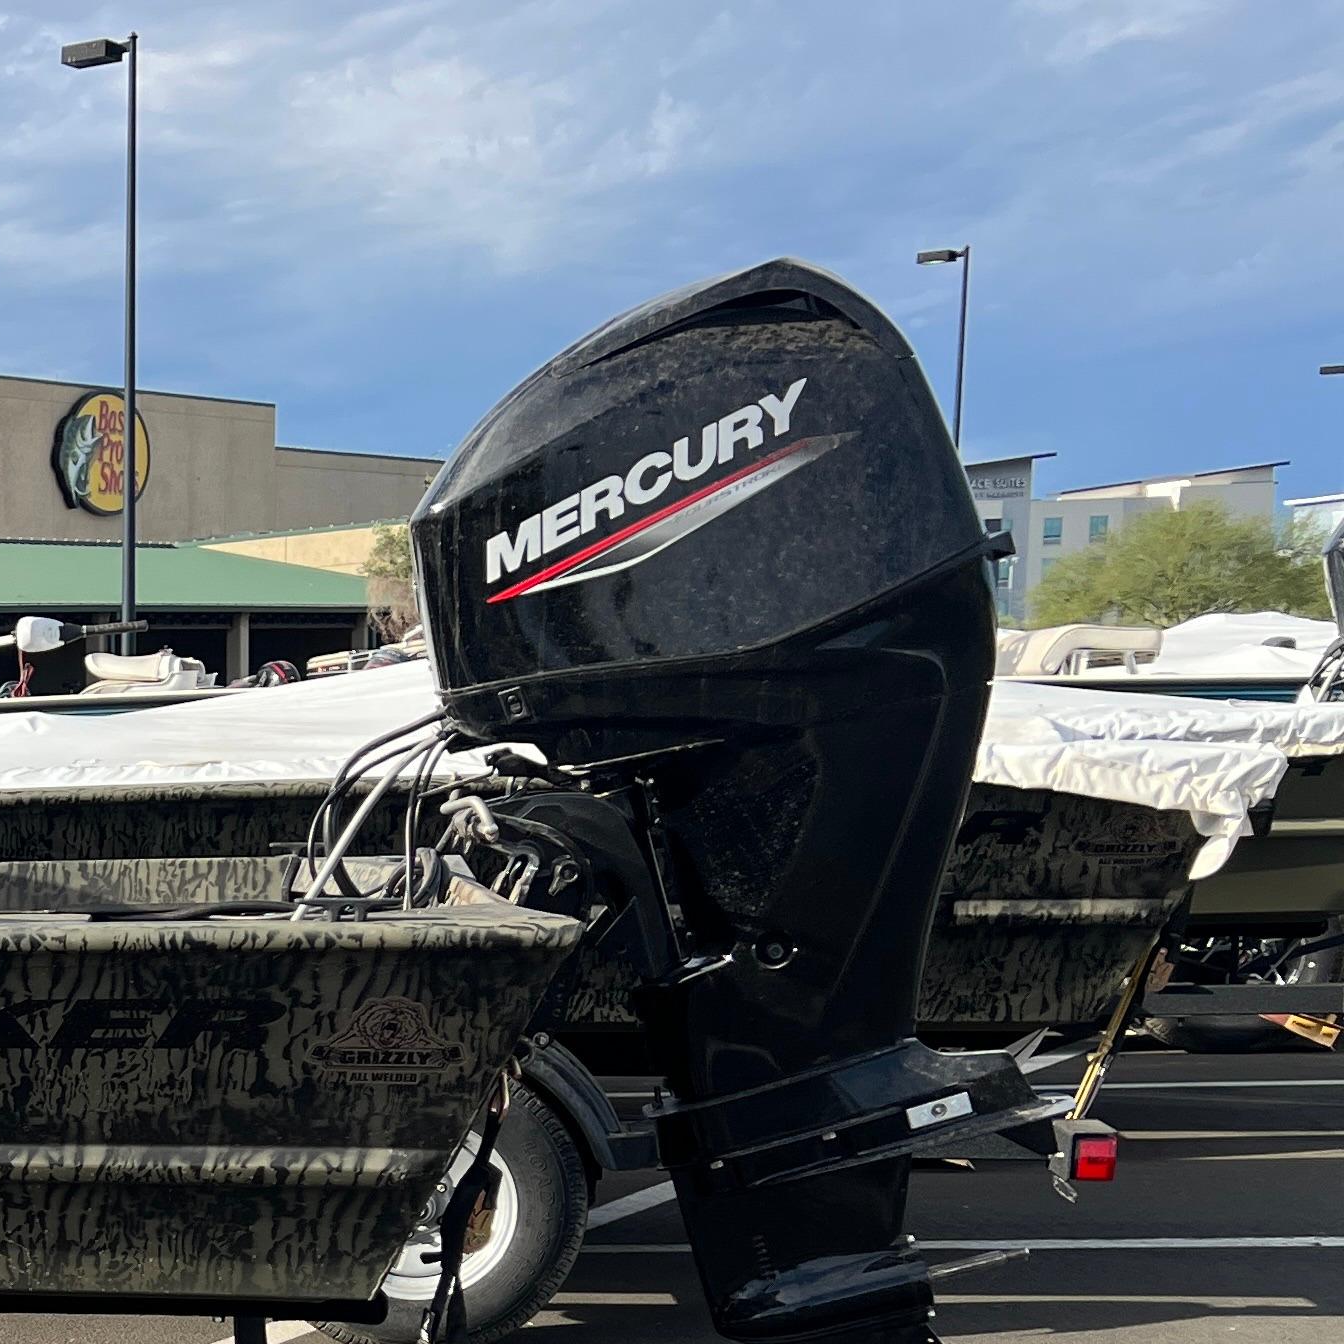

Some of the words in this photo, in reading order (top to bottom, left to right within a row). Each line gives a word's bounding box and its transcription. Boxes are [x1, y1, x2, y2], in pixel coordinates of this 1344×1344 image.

[98, 400, 125, 433] Bas
[99, 434, 124, 463] Pro
[486, 377, 807, 584] MERCURY
[339, 1050, 433, 1065] GRIZZLY
[349, 1072, 369, 1083] ALL
[372, 1072, 418, 1083] WELDED
